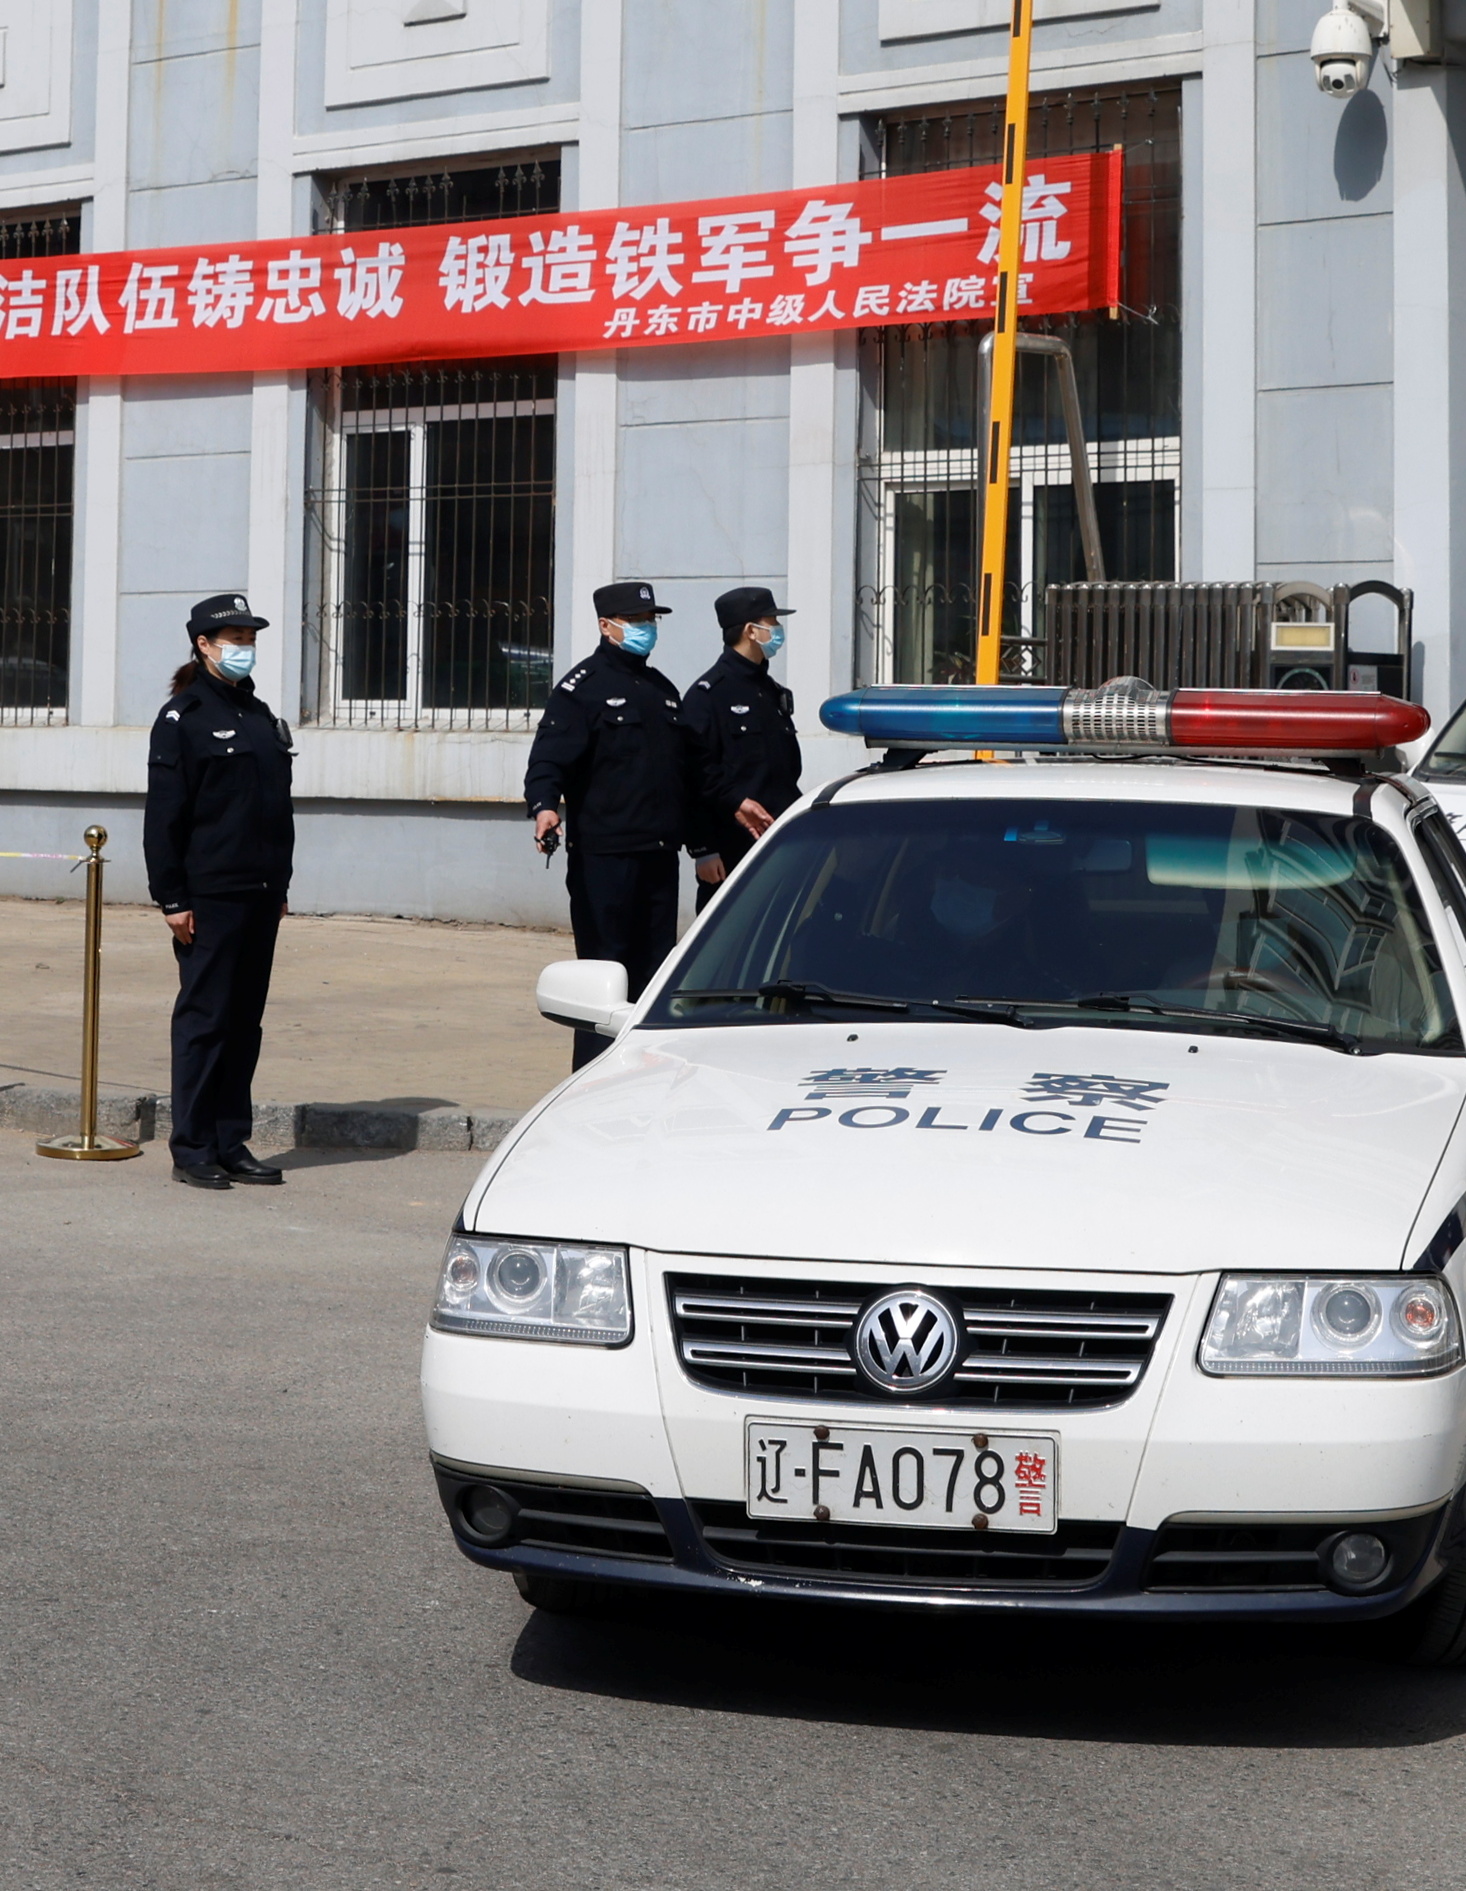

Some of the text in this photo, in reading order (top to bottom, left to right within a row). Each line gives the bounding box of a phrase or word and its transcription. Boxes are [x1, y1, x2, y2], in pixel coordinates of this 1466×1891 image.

[0, 174, 1072, 339] 洁队伍铸忠诚 锻造铁军争一流
[796, 1066, 1171, 1112] 警察
[766, 1105, 1148, 1143] POLICE
